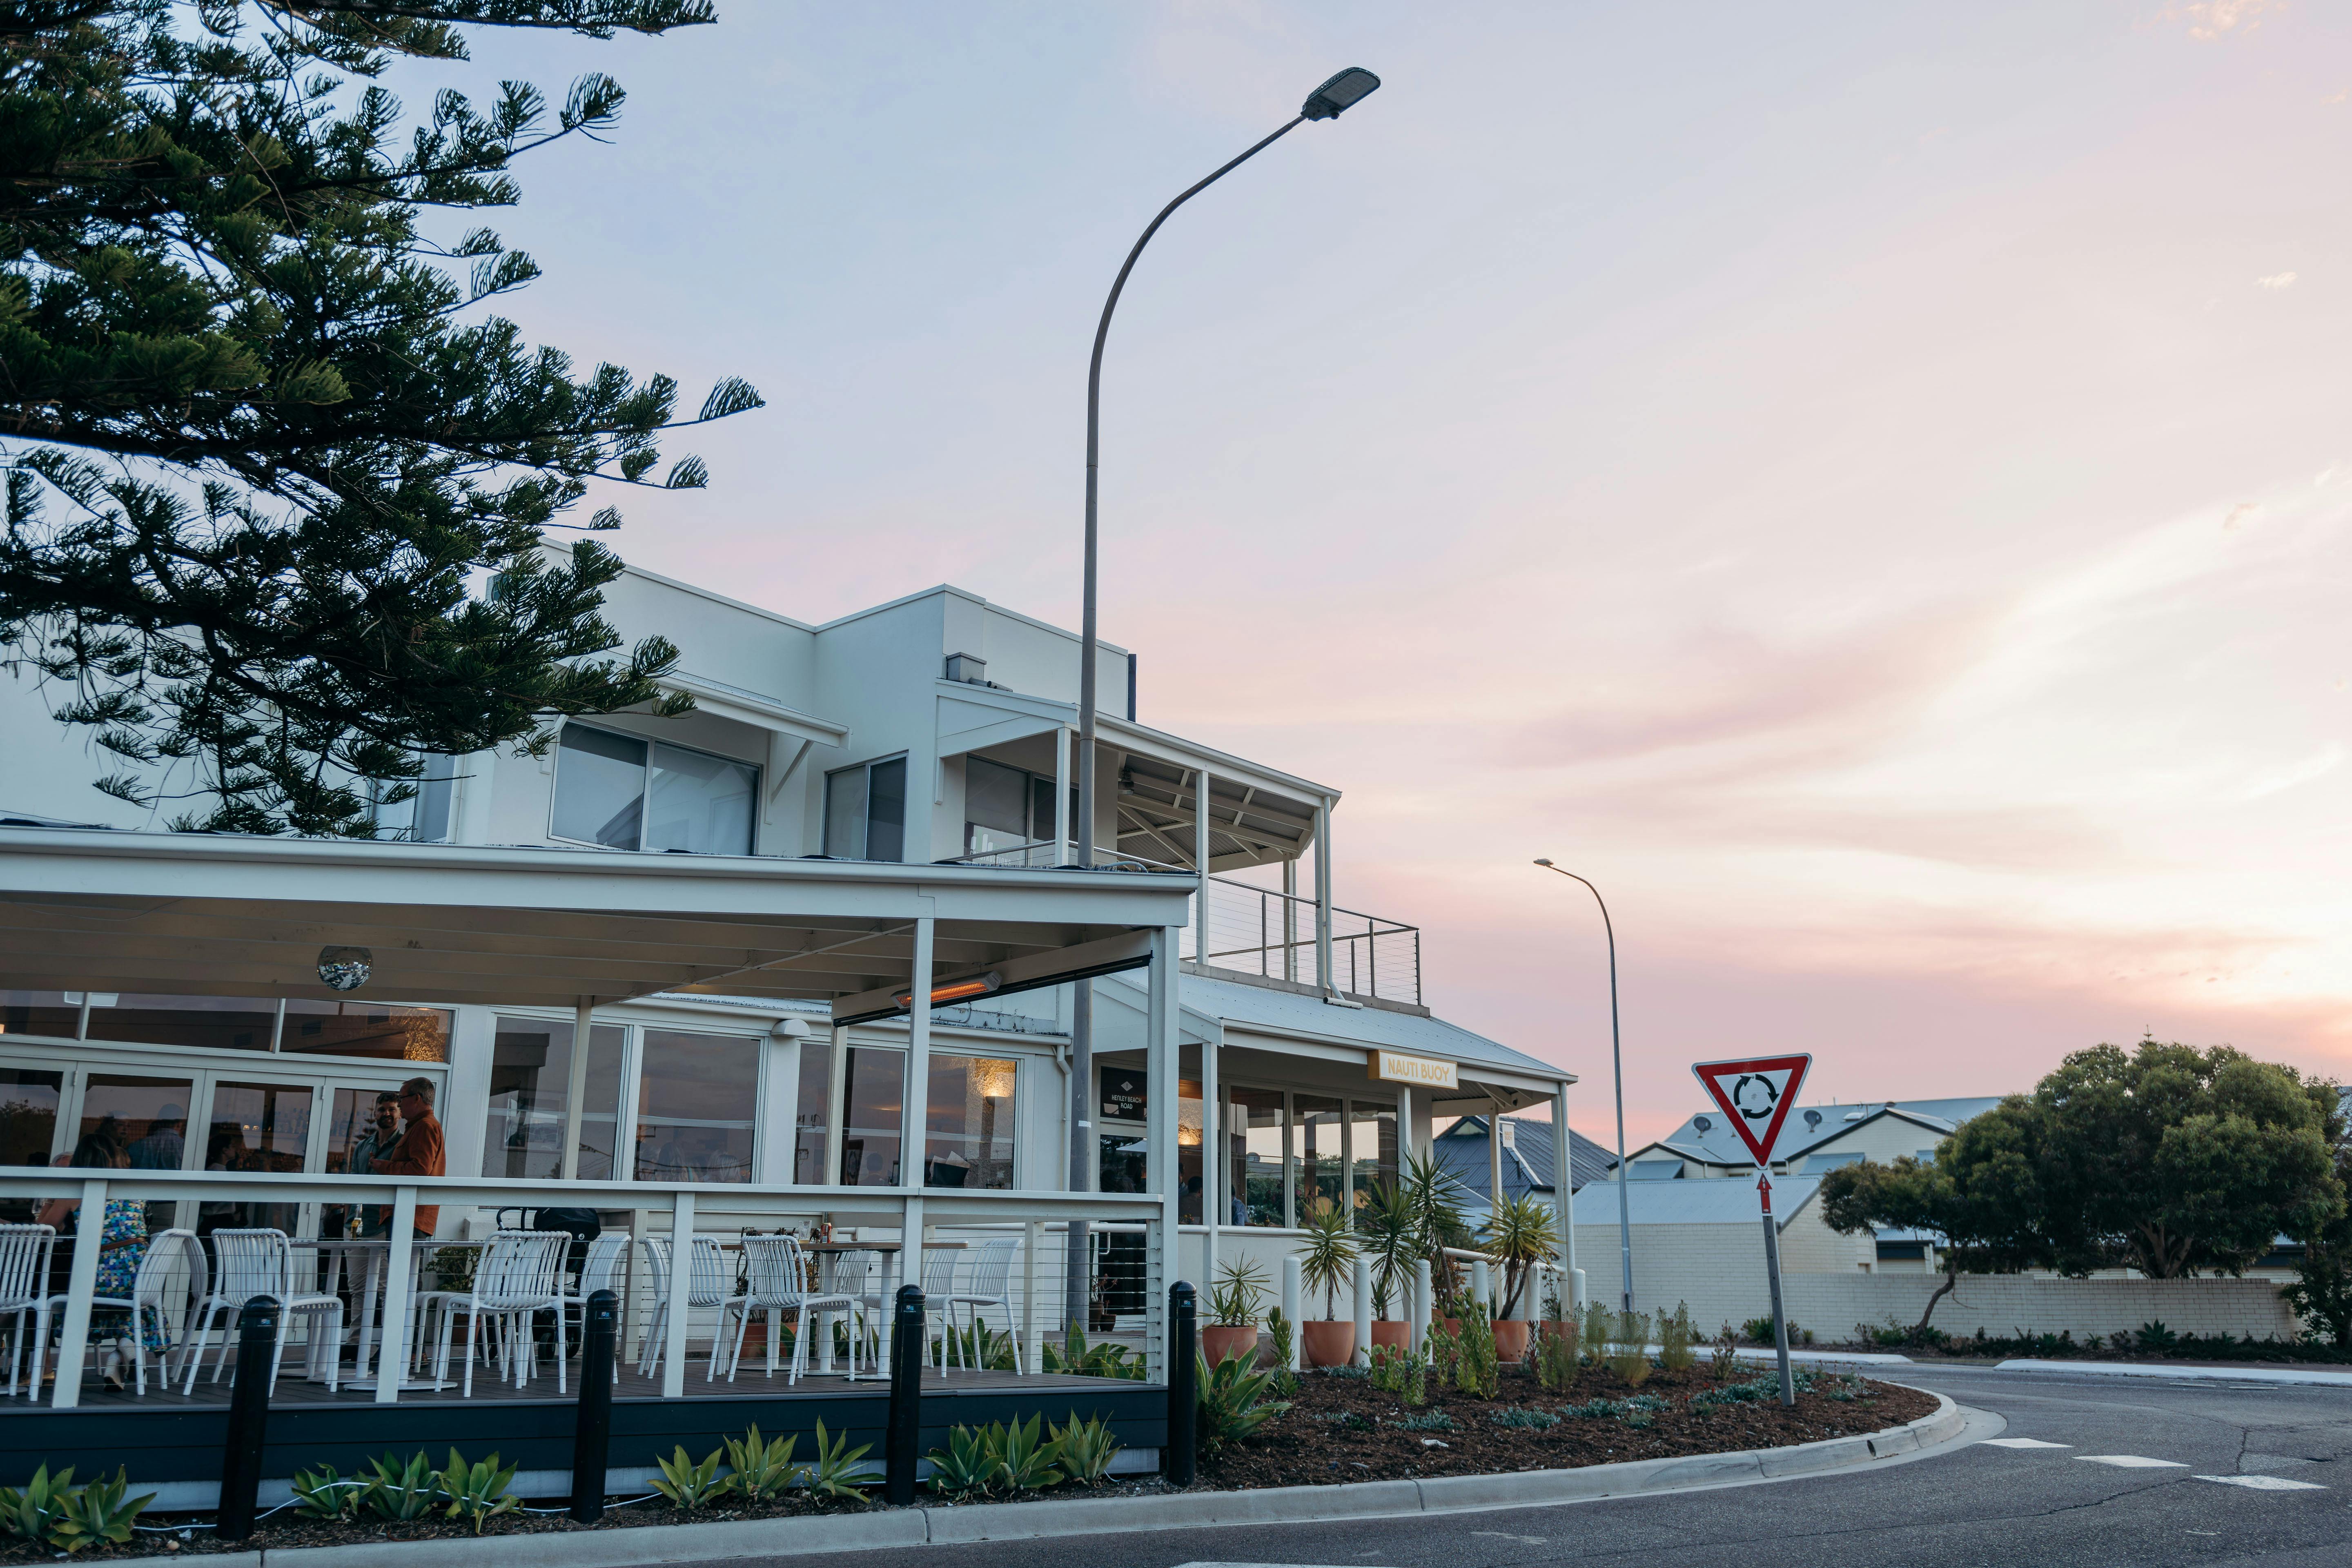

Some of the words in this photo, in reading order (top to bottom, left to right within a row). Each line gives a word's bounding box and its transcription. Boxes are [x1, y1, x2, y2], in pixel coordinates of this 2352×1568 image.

[970, 850, 1011, 865] CTRUCTIONS
[1388, 1058, 1418, 1078] NAUTI
[1421, 1063, 1449, 1082] BUOY
